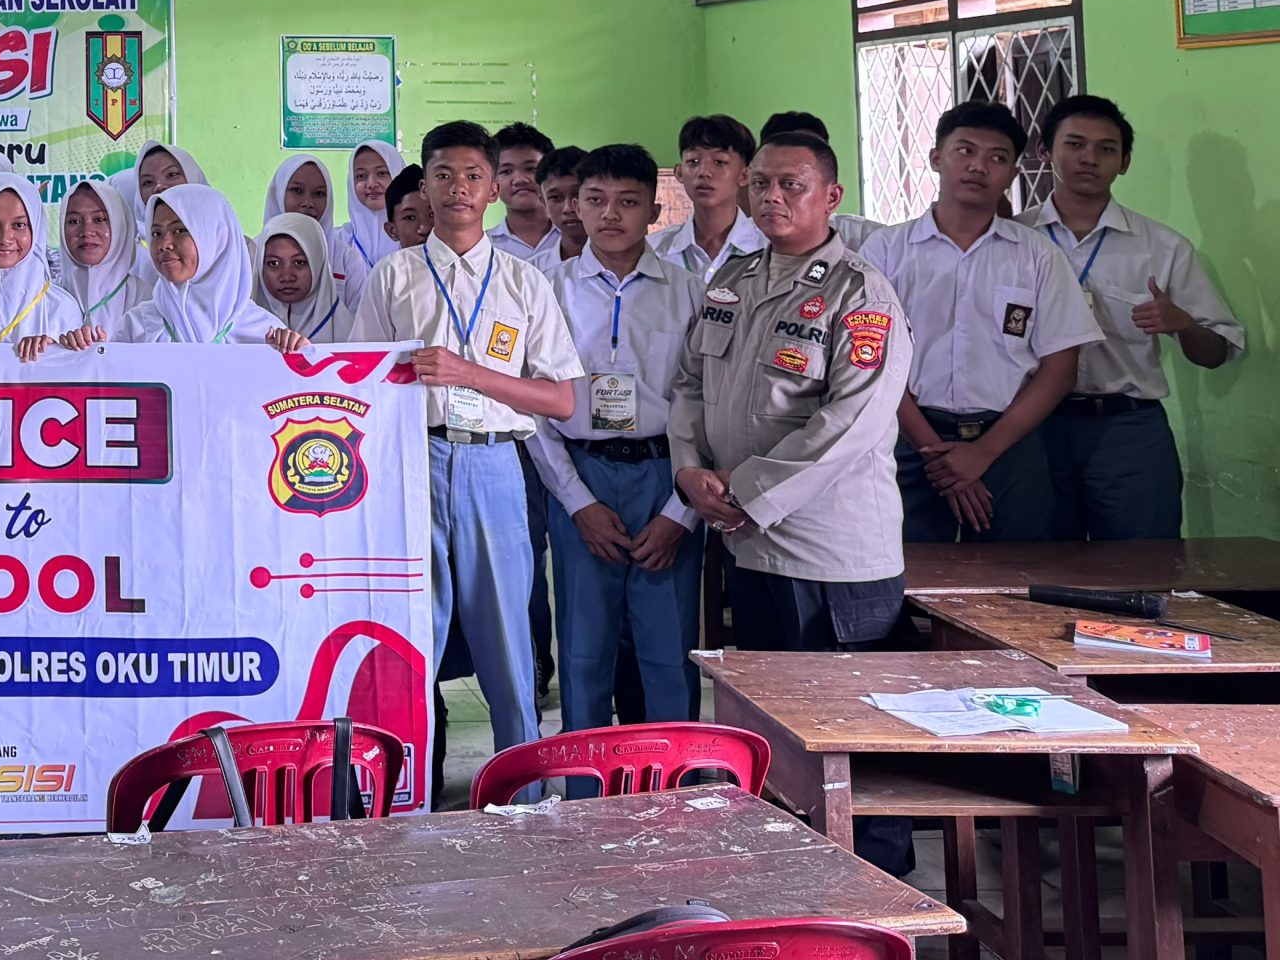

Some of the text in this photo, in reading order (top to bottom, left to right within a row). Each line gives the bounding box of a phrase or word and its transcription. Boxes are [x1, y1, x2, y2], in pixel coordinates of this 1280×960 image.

[318, 42, 347, 51] SEBELUM
[347, 42, 374, 51] BELAJAR
[847, 313, 889, 323] POLRES
[774, 321, 828, 346] POLRI
[267, 395, 367, 415] SUMATERA SELATAN
[4, 493, 52, 540] to
[96, 651, 159, 683] OKU
[167, 651, 262, 683] TIMUR
